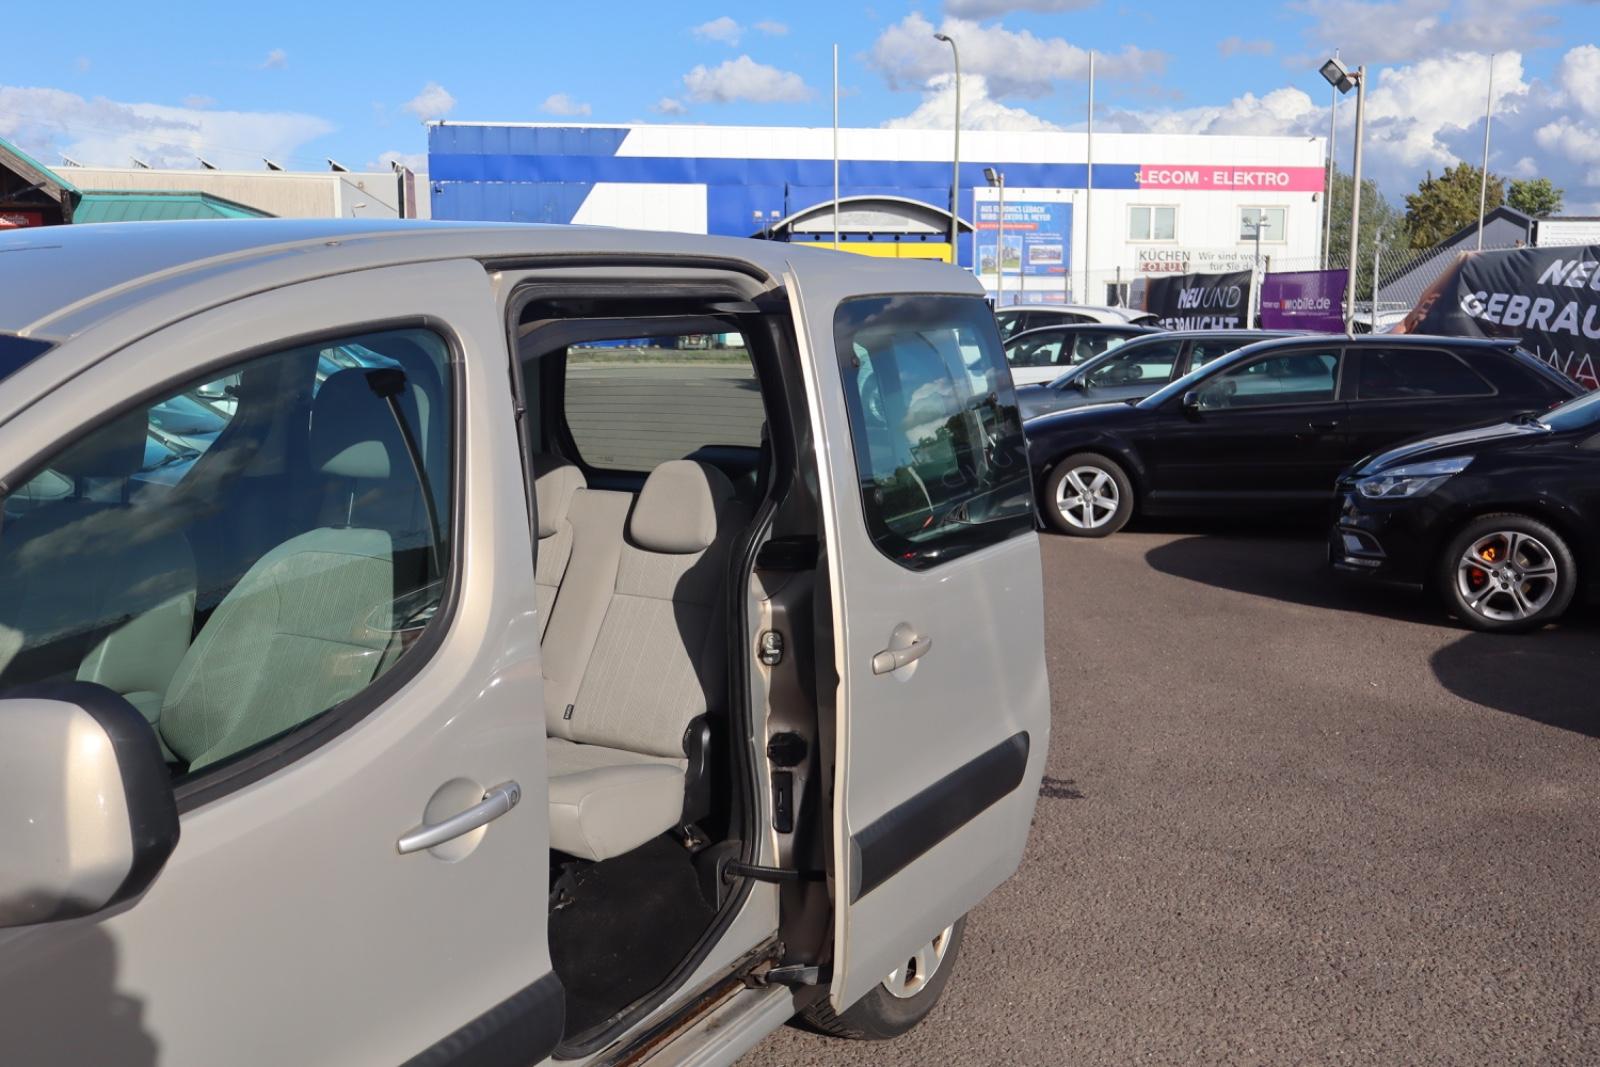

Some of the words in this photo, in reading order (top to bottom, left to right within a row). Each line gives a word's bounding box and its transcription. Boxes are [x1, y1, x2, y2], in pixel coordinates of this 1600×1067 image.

[1213, 171, 1290, 186] ELEKTRO
[1139, 247, 1191, 261] KÜCHEN
[1199, 251, 1214, 261] Wir
[1218, 251, 1238, 261] sind
[1177, 287, 1204, 309] NEU
[1203, 286, 1242, 308] UND
